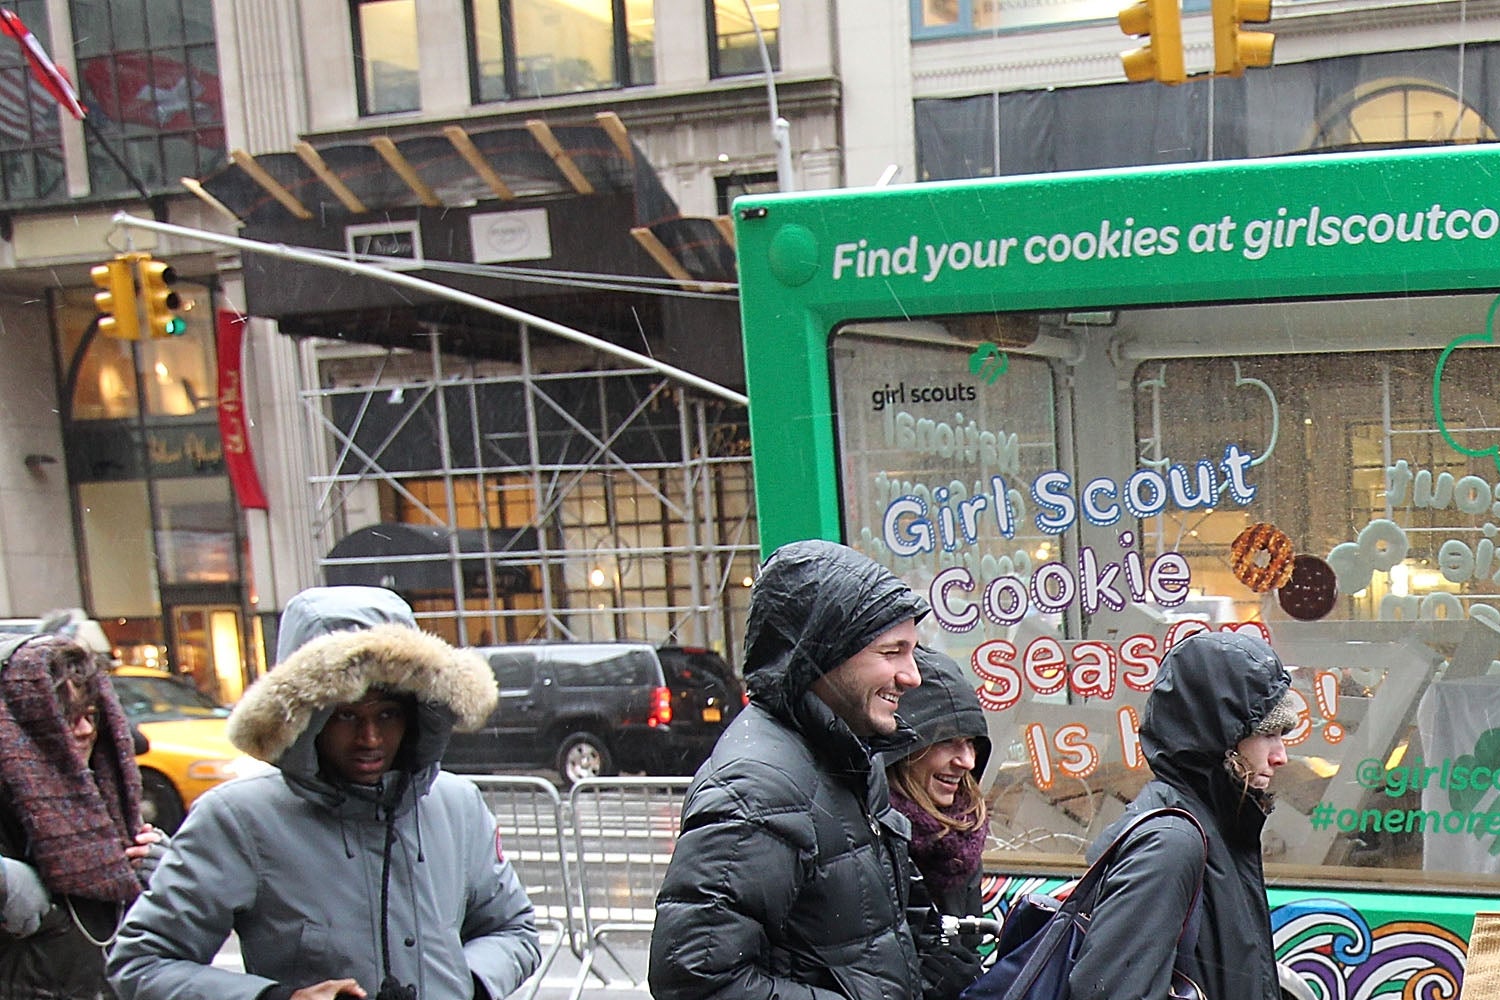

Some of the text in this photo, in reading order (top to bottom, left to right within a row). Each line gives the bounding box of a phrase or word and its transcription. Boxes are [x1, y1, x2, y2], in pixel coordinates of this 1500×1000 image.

[832, 235, 919, 280] Find
[923, 235, 1018, 282] your
[1022, 216, 1180, 264] cookies
[1187, 214, 1237, 254] at
[872, 382, 977, 411] girl scouts
[884, 475, 1014, 558] Girl
[1031, 445, 1257, 534] Scout
[930, 530, 1192, 633] Cookie
[1026, 722, 1098, 791] Is
